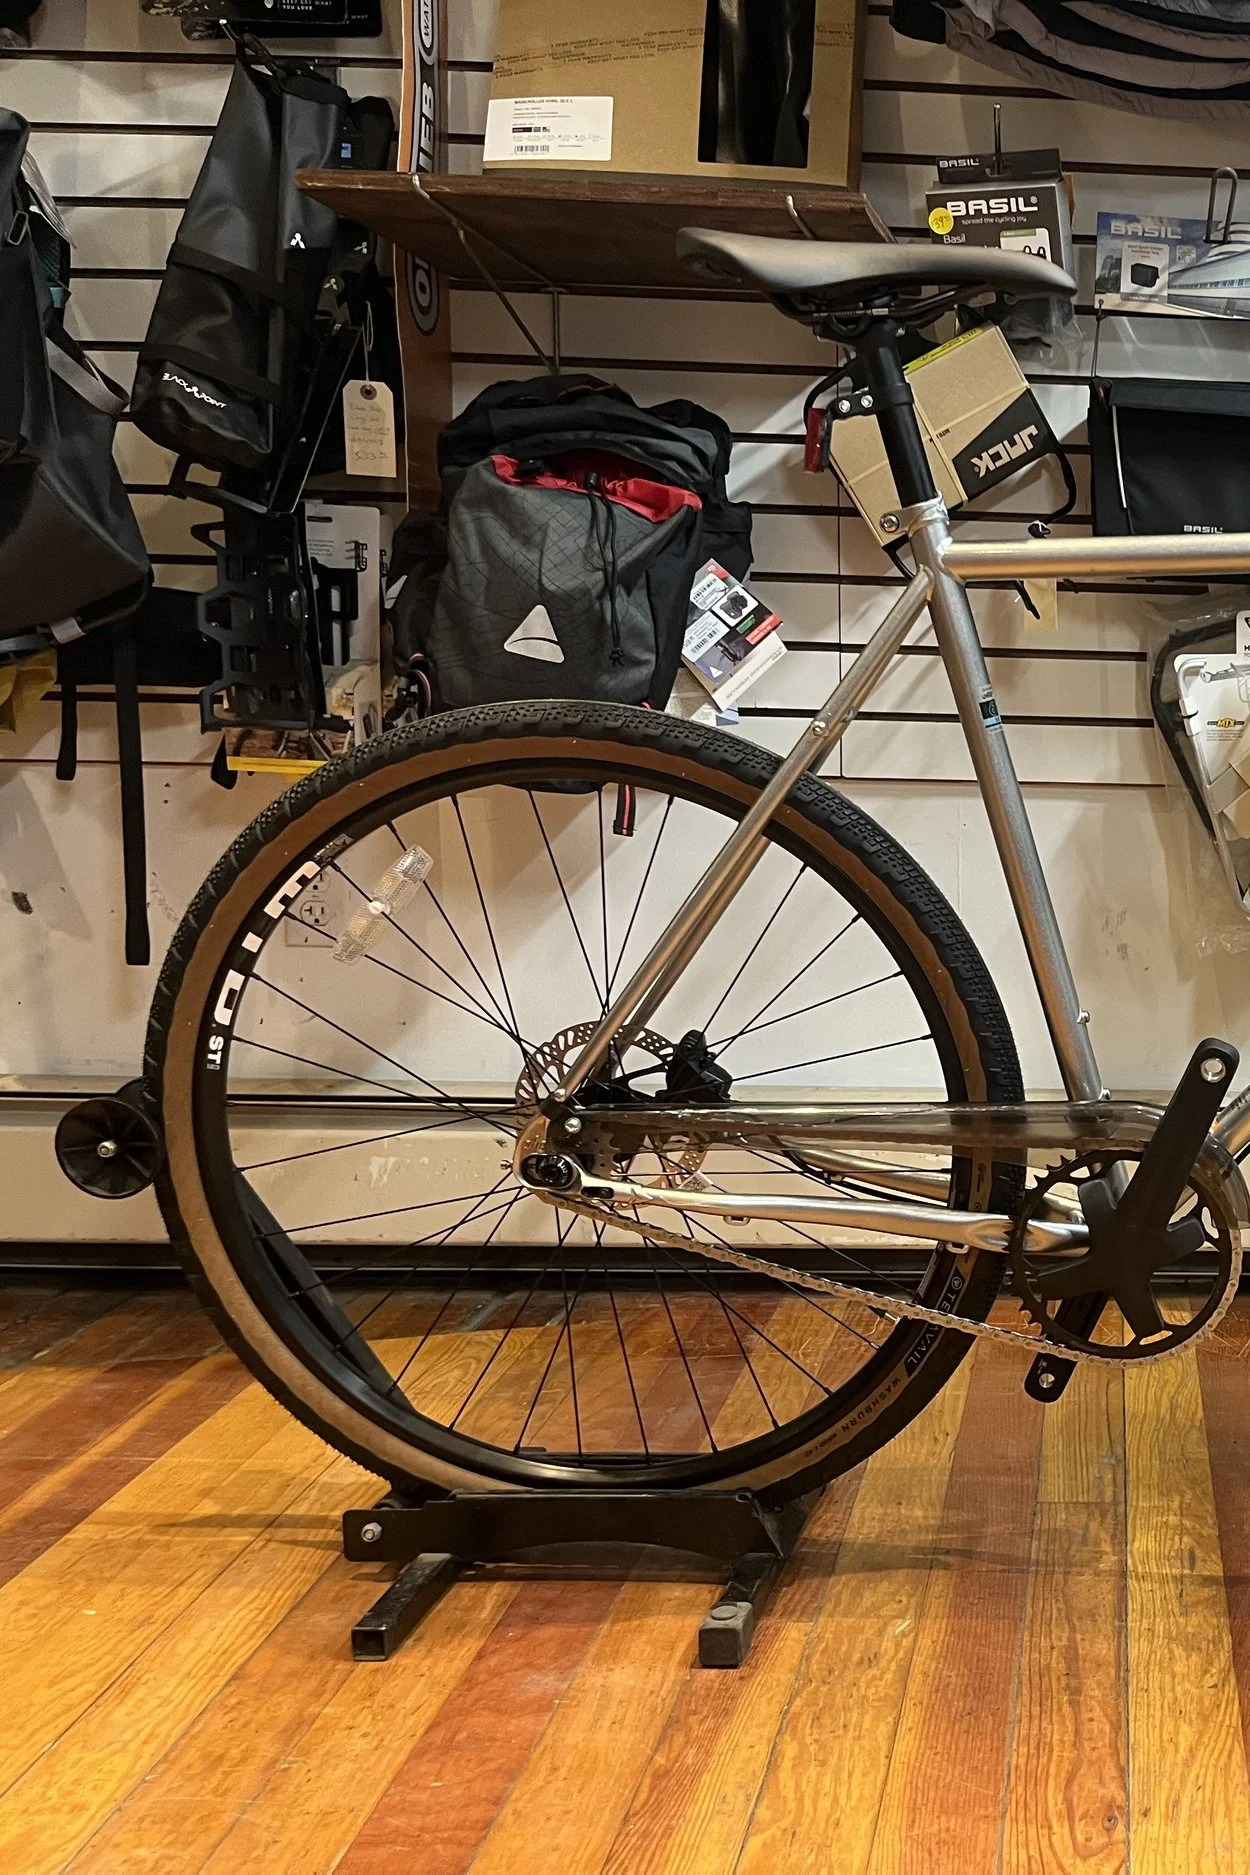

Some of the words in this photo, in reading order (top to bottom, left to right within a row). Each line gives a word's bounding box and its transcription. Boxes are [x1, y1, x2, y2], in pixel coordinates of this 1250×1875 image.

[939, 158, 977, 168] BASIL
[946, 196, 1039, 217] BASIL
[1110, 220, 1182, 239] BASIL
[943, 234, 966, 244] Basil
[1183, 525, 1223, 534] BASIL
[841, 1377, 901, 1432] WASHBURN
